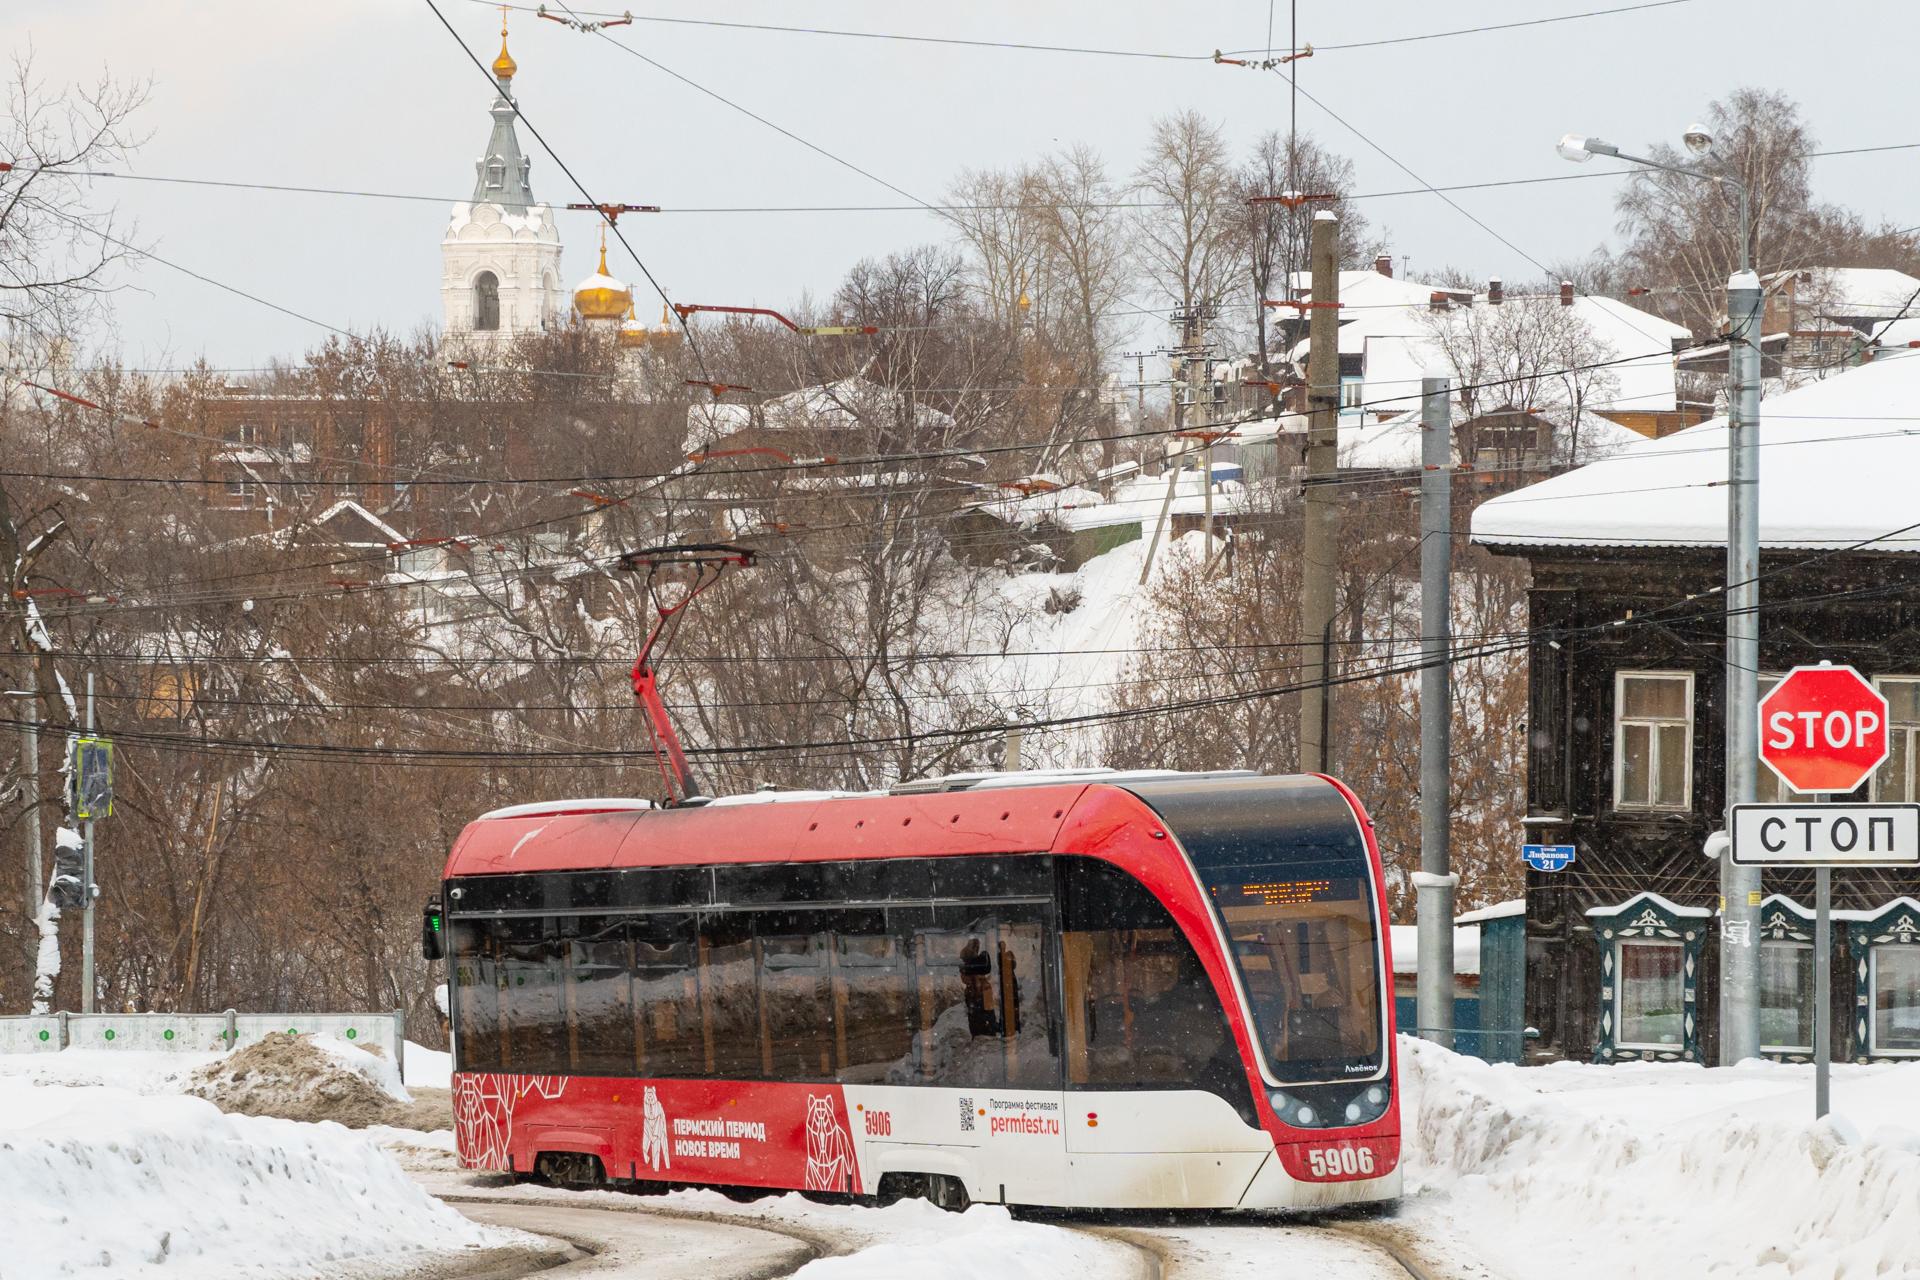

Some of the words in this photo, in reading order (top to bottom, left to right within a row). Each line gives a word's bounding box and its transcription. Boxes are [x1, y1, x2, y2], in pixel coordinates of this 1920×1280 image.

[1768, 710, 1879, 749] STOP
[1760, 817, 1894, 852] СТОП
[1542, 860, 1555, 870] 21
[989, 1099, 1024, 1110] Программа
[1025, 1100, 1058, 1111] фестиваля
[673, 1117, 725, 1137] ПЕРМСКИЙ
[726, 1121, 766, 1142] ПЕРИОД
[865, 1110, 891, 1136] 5906
[991, 1113, 1059, 1137] permfest.ru
[675, 1139, 707, 1157] НОВОЕ
[708, 1141, 740, 1159] ВРЕМЯ
[1308, 1147, 1375, 1177] 5906
